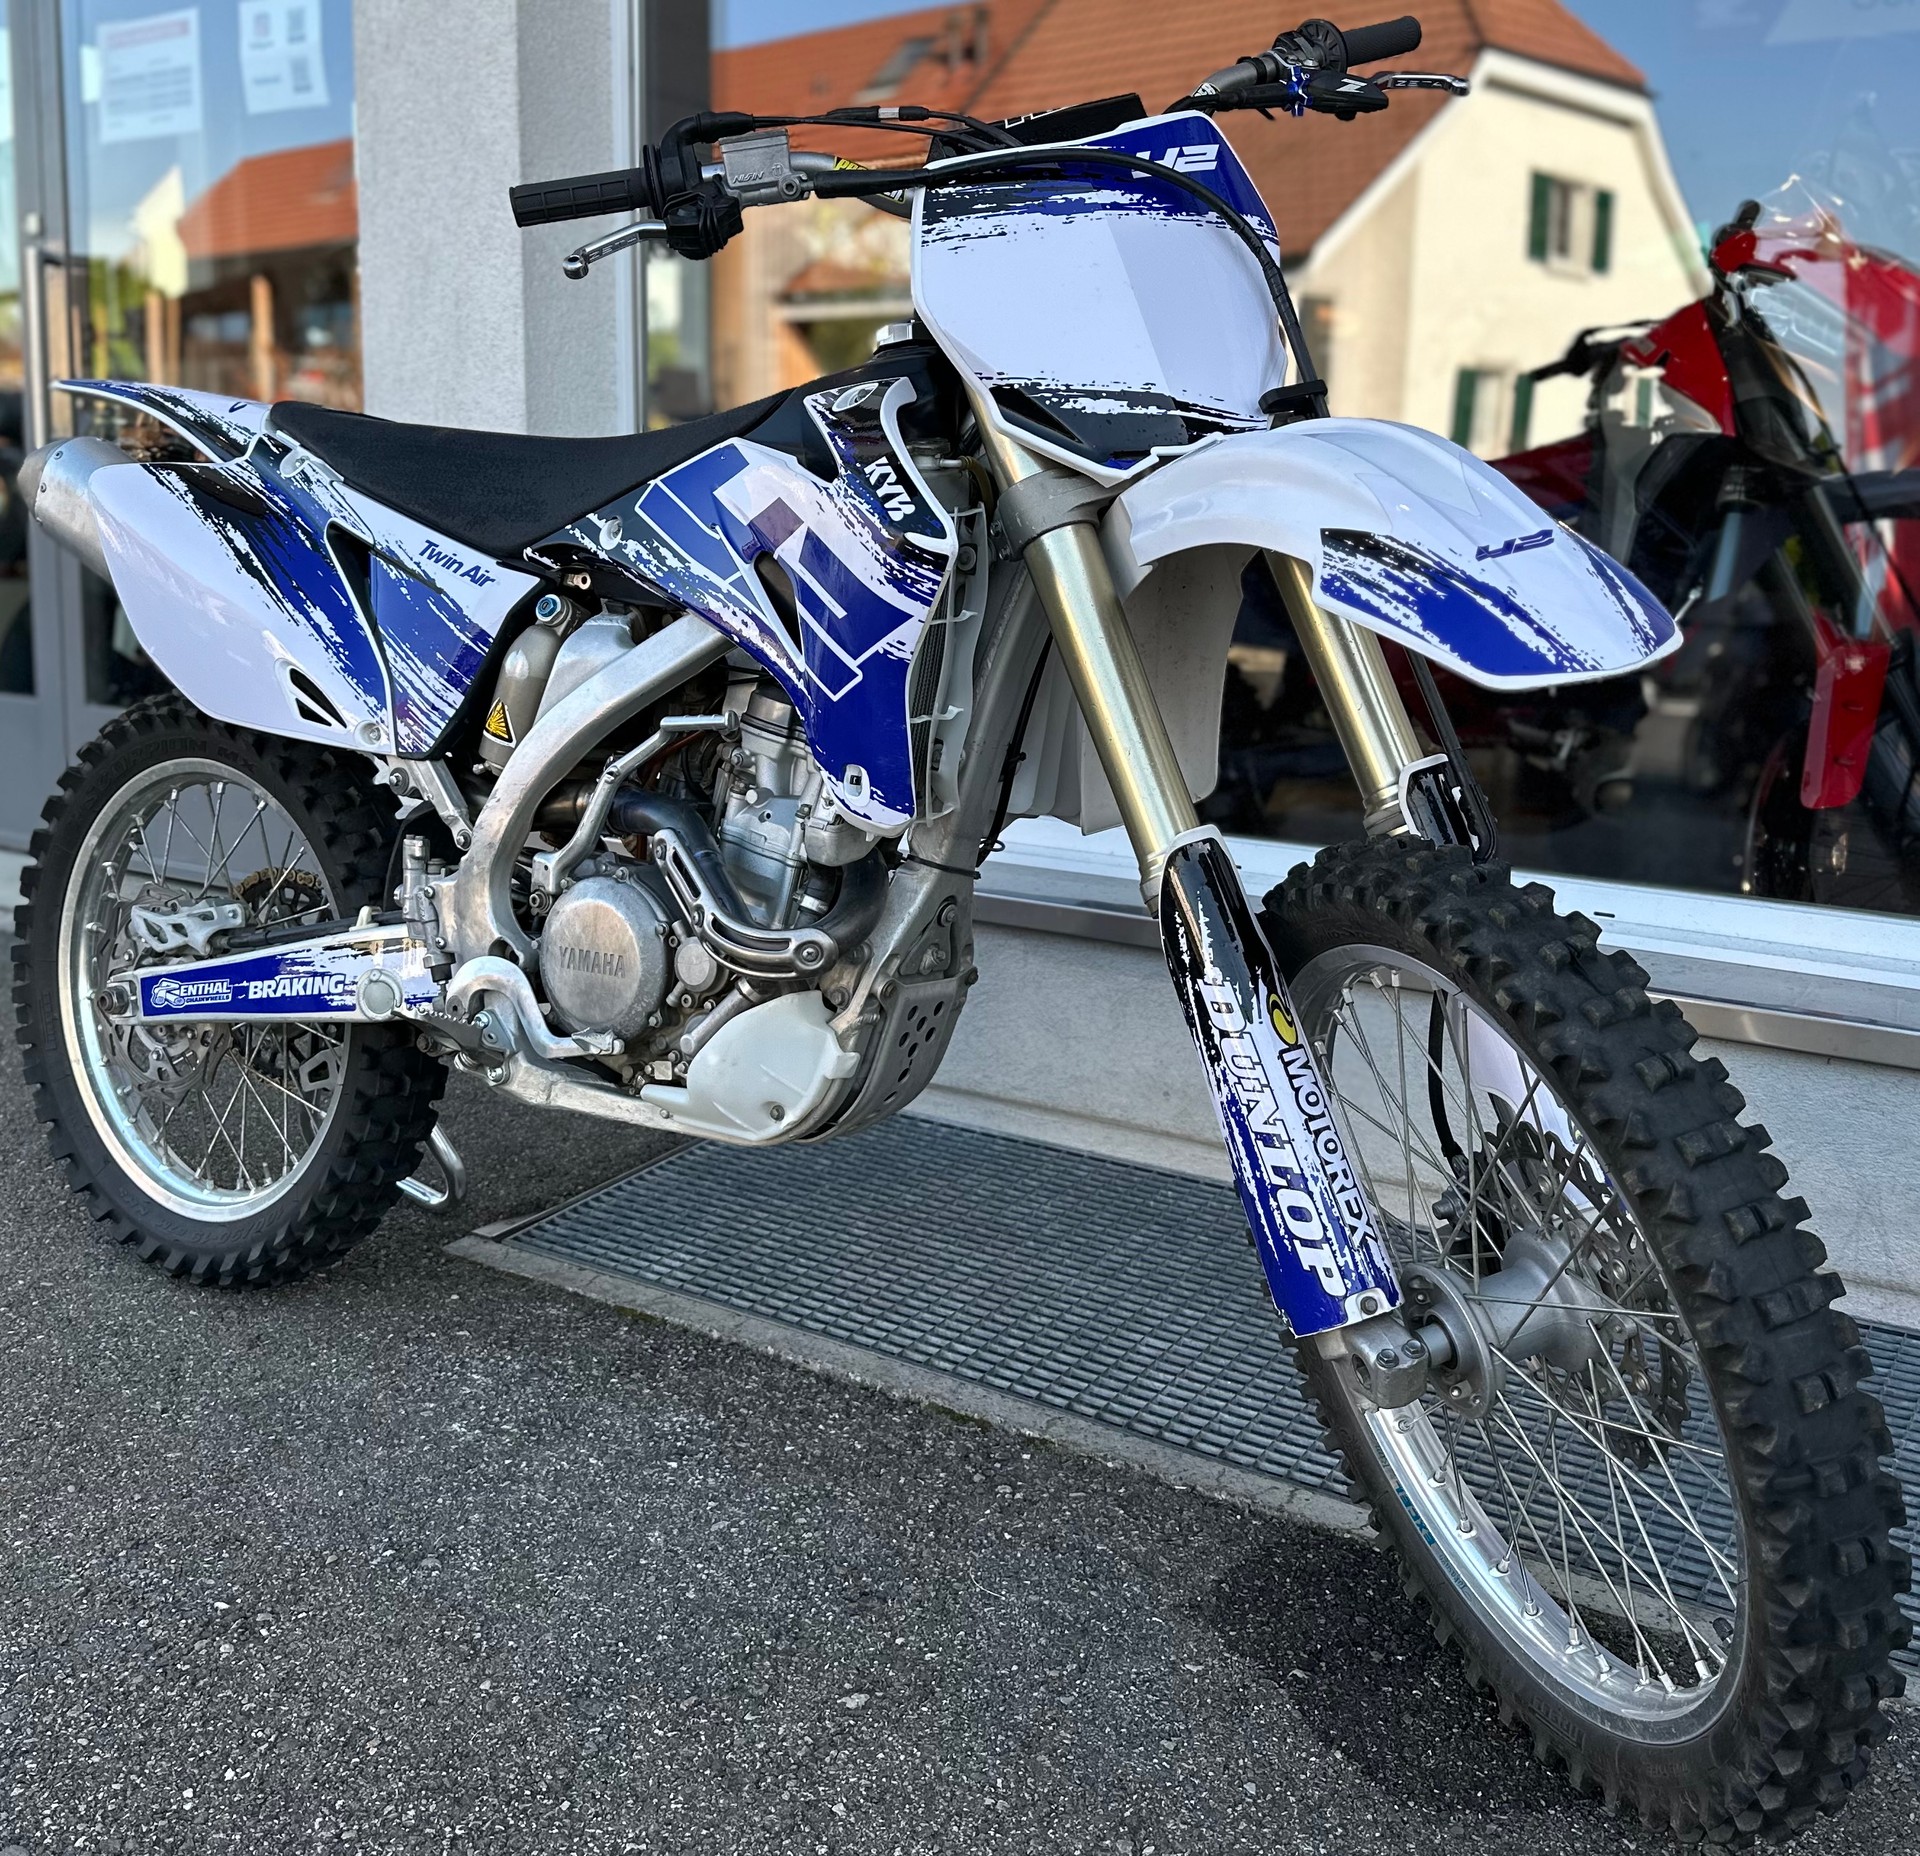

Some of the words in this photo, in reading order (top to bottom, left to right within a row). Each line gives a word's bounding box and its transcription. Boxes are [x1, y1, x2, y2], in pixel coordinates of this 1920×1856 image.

[863, 456, 916, 522] KYB
[418, 539, 464, 574] Twin
[459, 564, 496, 588] Air
[248, 973, 347, 1000] BRAKING
[558, 945, 627, 979] YAMAHA
[1196, 978, 1348, 1298] DUNLOP
[1278, 1044, 1379, 1243] MOTOREX
[1395, 1481, 1437, 1547] EXCEL
